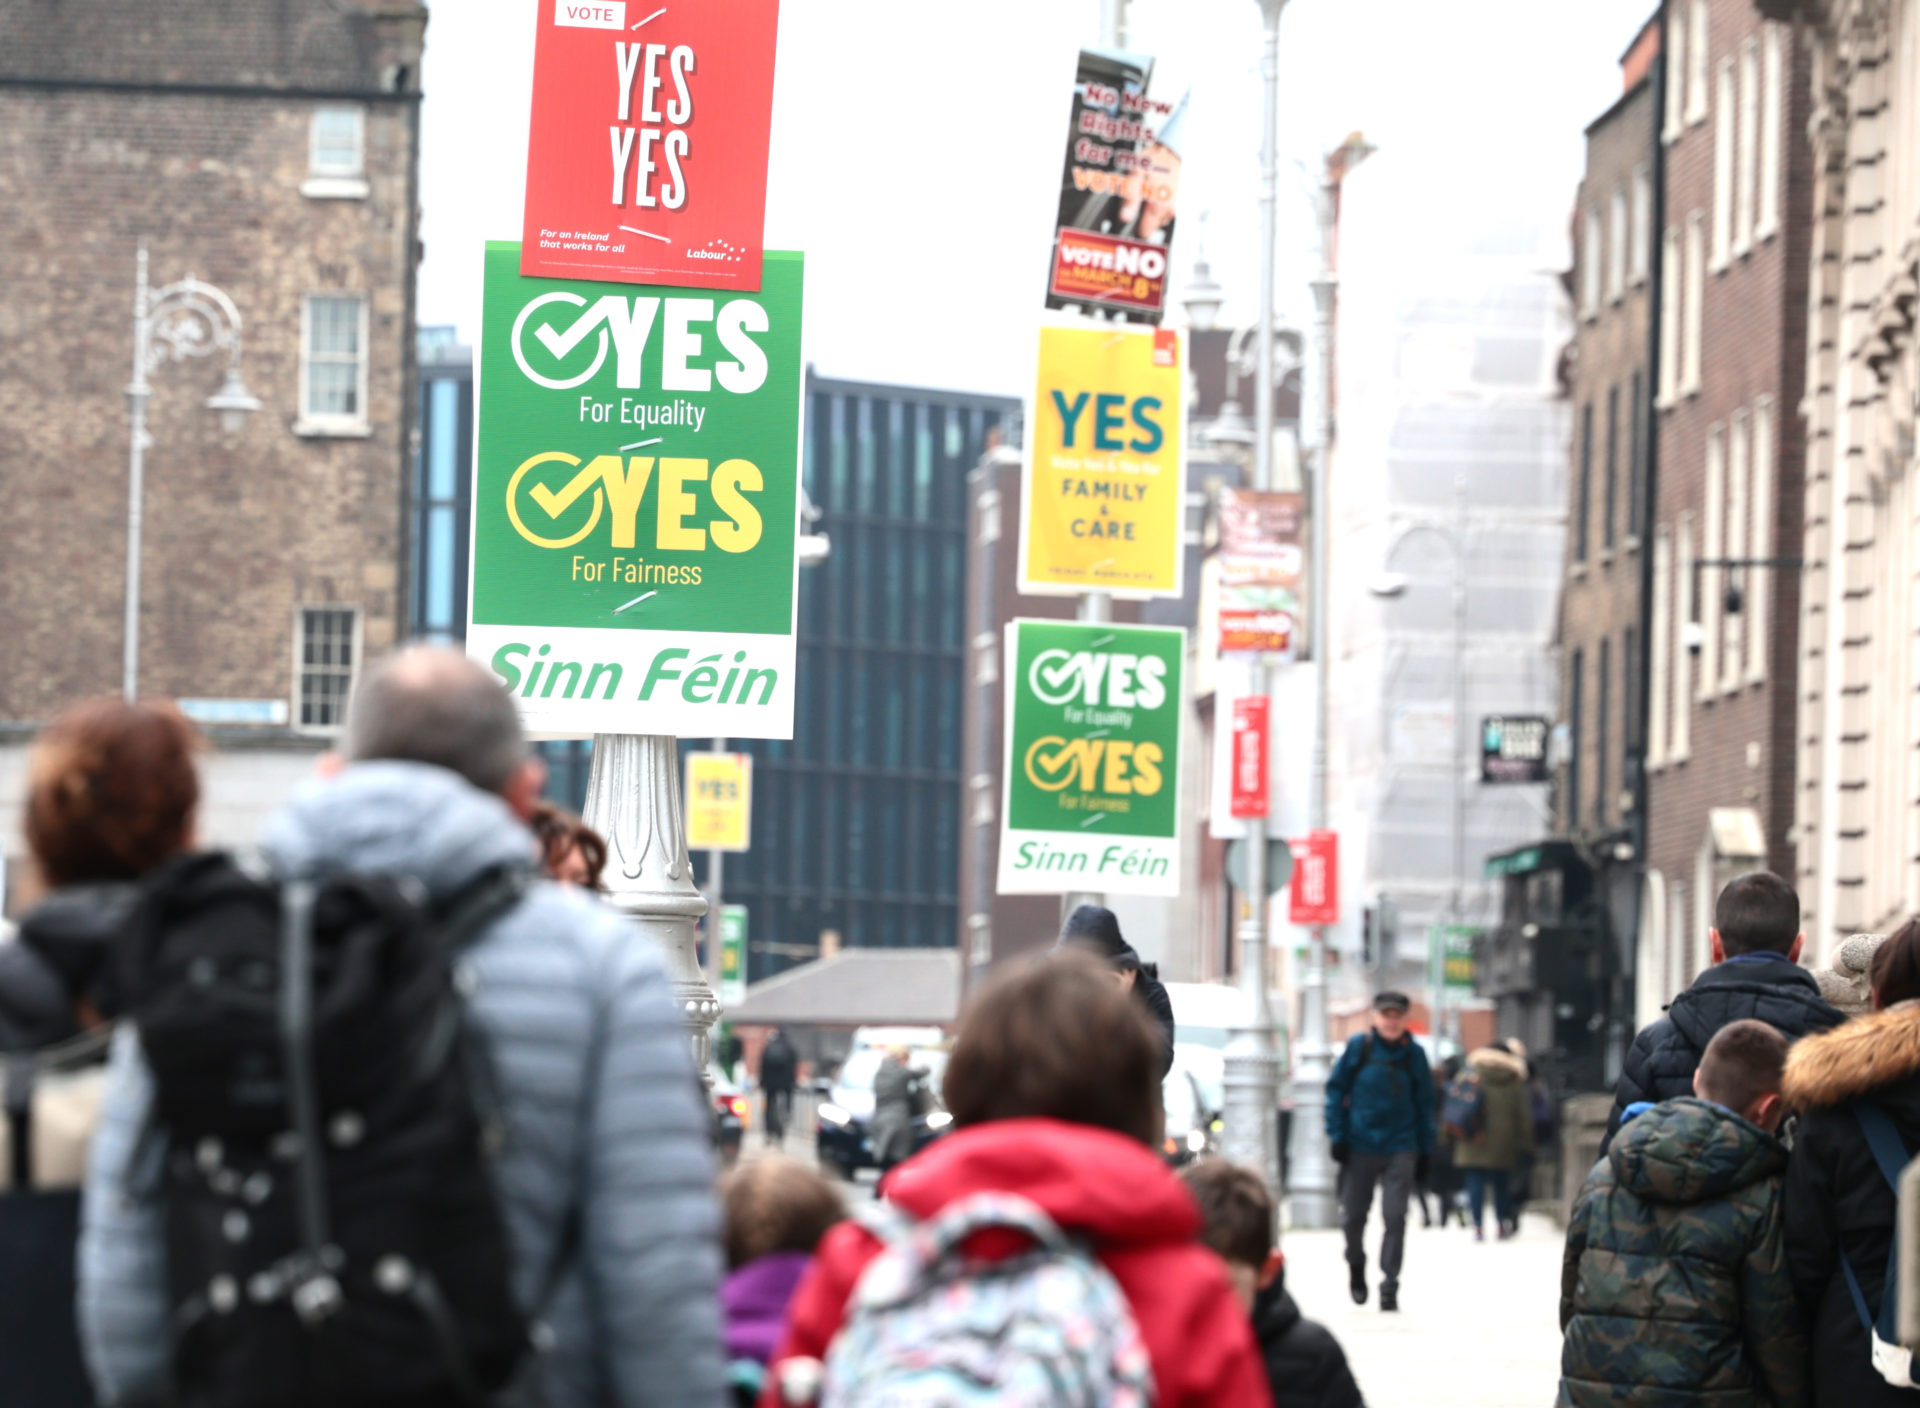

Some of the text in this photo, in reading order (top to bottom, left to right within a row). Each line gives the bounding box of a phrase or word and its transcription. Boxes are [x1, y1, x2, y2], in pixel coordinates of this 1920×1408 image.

[566, 6, 613, 22] VOTE
[615, 41, 695, 125] YES
[1085, 85, 1173, 116] No New
[1080, 111, 1154, 140] Rights
[1077, 139, 1111, 164] for
[609, 126, 690, 209] YES
[540, 229, 609, 241] For an Ireland
[540, 240, 625, 253] that works for all
[687, 249, 726, 261] Labour
[1062, 244, 1166, 279] VOTE NO
[598, 294, 770, 394] YES
[579, 397, 706, 432] For Equality
[1051, 389, 1164, 454] YES
[593, 454, 764, 554] YES
[1062, 478, 1148, 501] FAMILY
[1100, 504, 1109, 516] &
[1070, 518, 1136, 541] CARE
[572, 555, 703, 585] For Fairness
[490, 641, 779, 706] Sinn Féin
[1076, 651, 1167, 710] YES
[1064, 706, 1133, 729] For Equality
[1072, 738, 1163, 796] YES
[1013, 840, 1169, 877] Sinn Féin
